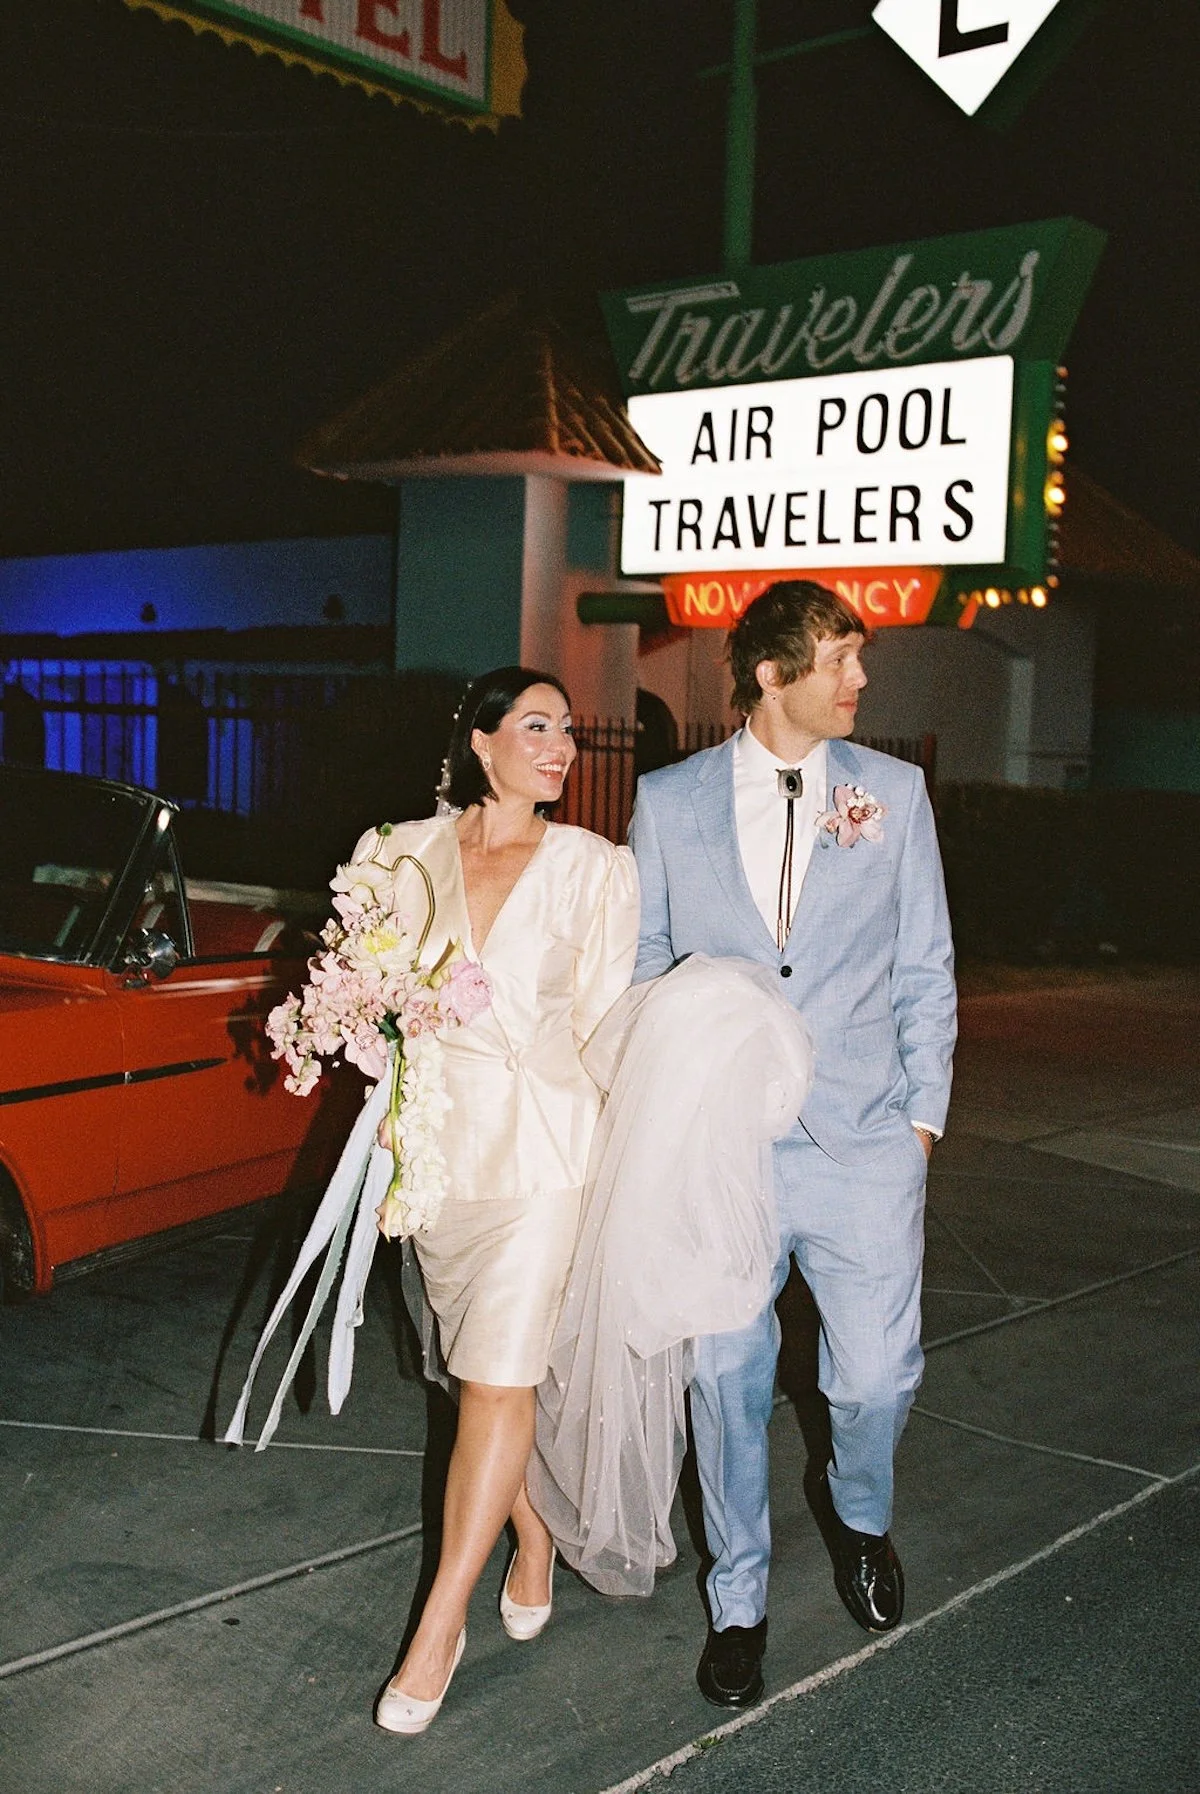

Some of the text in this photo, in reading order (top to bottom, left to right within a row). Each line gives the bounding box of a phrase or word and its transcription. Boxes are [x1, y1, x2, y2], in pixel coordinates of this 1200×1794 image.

[299, 0, 468, 83] EL
[625, 249, 1041, 387] Travelers
[690, 388, 967, 465] AIR POOL
[648, 479, 975, 552] TRAVELERS
[727, 578, 920, 618] VNCY
